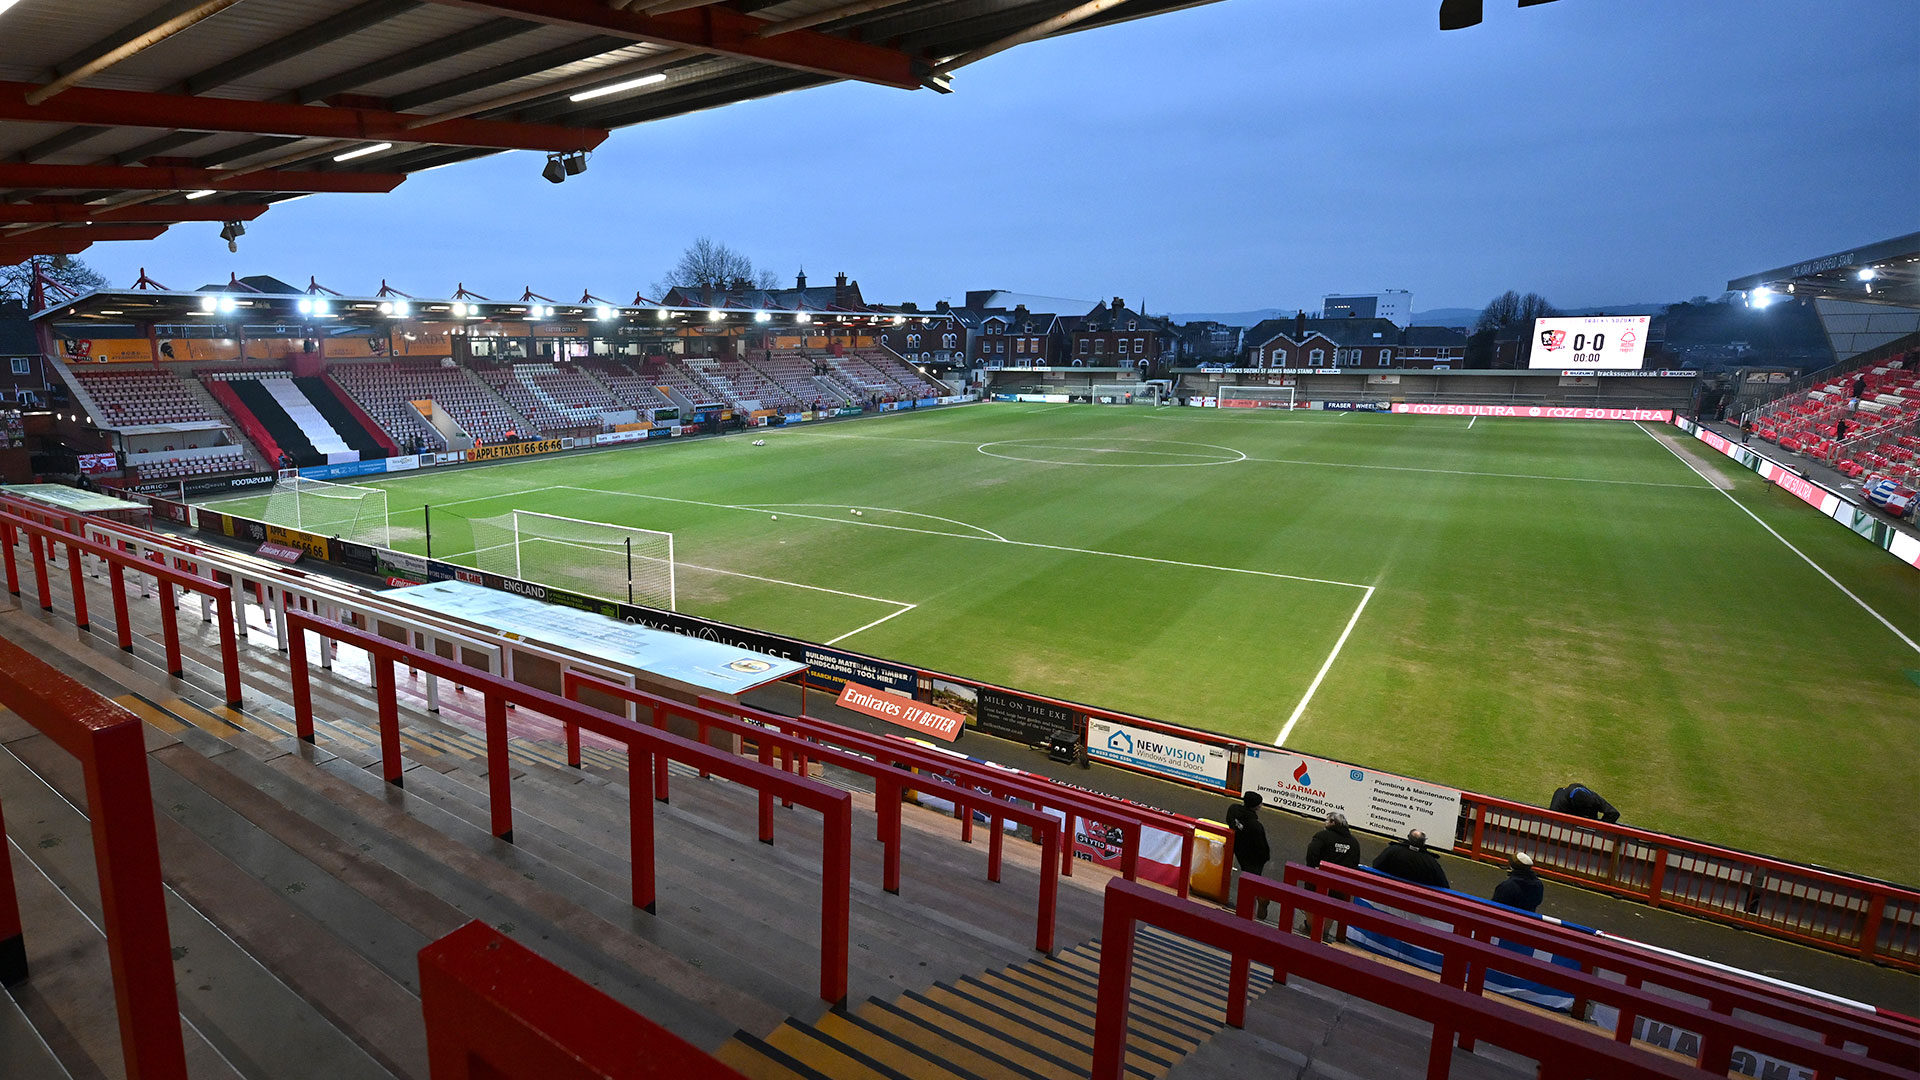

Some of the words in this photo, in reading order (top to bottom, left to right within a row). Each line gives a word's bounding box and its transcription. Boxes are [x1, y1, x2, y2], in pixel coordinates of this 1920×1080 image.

[1573, 333, 1605, 351] 0-0
[1573, 353, 1600, 362] 00:00
[1413, 405, 1445, 413] razr
[1447, 405, 1465, 414] 50
[1469, 405, 1516, 415] ULTRA
[1546, 408, 1582, 417] razr
[1584, 408, 1605, 418] 50
[1610, 409, 1664, 420] ULTRA
[476, 447, 498, 460] APPLE
[500, 444, 520, 457] TAXIS
[134, 483, 168, 492] FABRICO
[270, 526, 287, 538] APPLE
[302, 543, 312, 555] 66
[313, 544, 324, 558] 66
[391, 578, 418, 587] Emirat
[456, 571, 468, 581] TOOL
[468, 573, 482, 585] CARE
[503, 579, 545, 599] ENGLAND
[805, 651, 837, 664] BUILDING
[838, 657, 877, 673] MATERIALS
[881, 668, 908, 681] TIMBER
[805, 657, 852, 674] LANDSCAPING
[857, 669, 875, 680] TOOL
[877, 674, 893, 685] HIRE
[811, 671, 832, 681] SEARCH
[844, 687, 901, 716] Emirates
[902, 706, 922, 722] FLY
[919, 711, 957, 733] BETTER
[984, 695, 1006, 707] MILL
[1009, 701, 1023, 710] ON
[1027, 704, 1045, 716] THE
[1048, 710, 1067, 721] EXE
[1136, 749, 1167, 763] Windows
[1169, 758, 1182, 767] and
[1183, 761, 1204, 772] Doors
[1137, 740, 1163, 753] NEW
[1165, 746, 1205, 764] VISION
[1257, 784, 1345, 811] jarman09@hotmail.co.uk
[1277, 780, 1284, 788] S
[1285, 783, 1326, 798] JARMAN
[1373, 788, 1408, 800] Renewable
[1409, 796, 1433, 807] Energy
[1374, 779, 1405, 792] Plumbing
[1413, 788, 1455, 802] Maintenance
[1273, 796, 1326, 815] 07928257500
[1371, 804, 1411, 818] Renovations
[1372, 796, 1407, 809] Bathrooms
[1416, 806, 1434, 816] Tiling
[1369, 821, 1397, 833] Kitchens
[1370, 813, 1406, 826] Extensions
